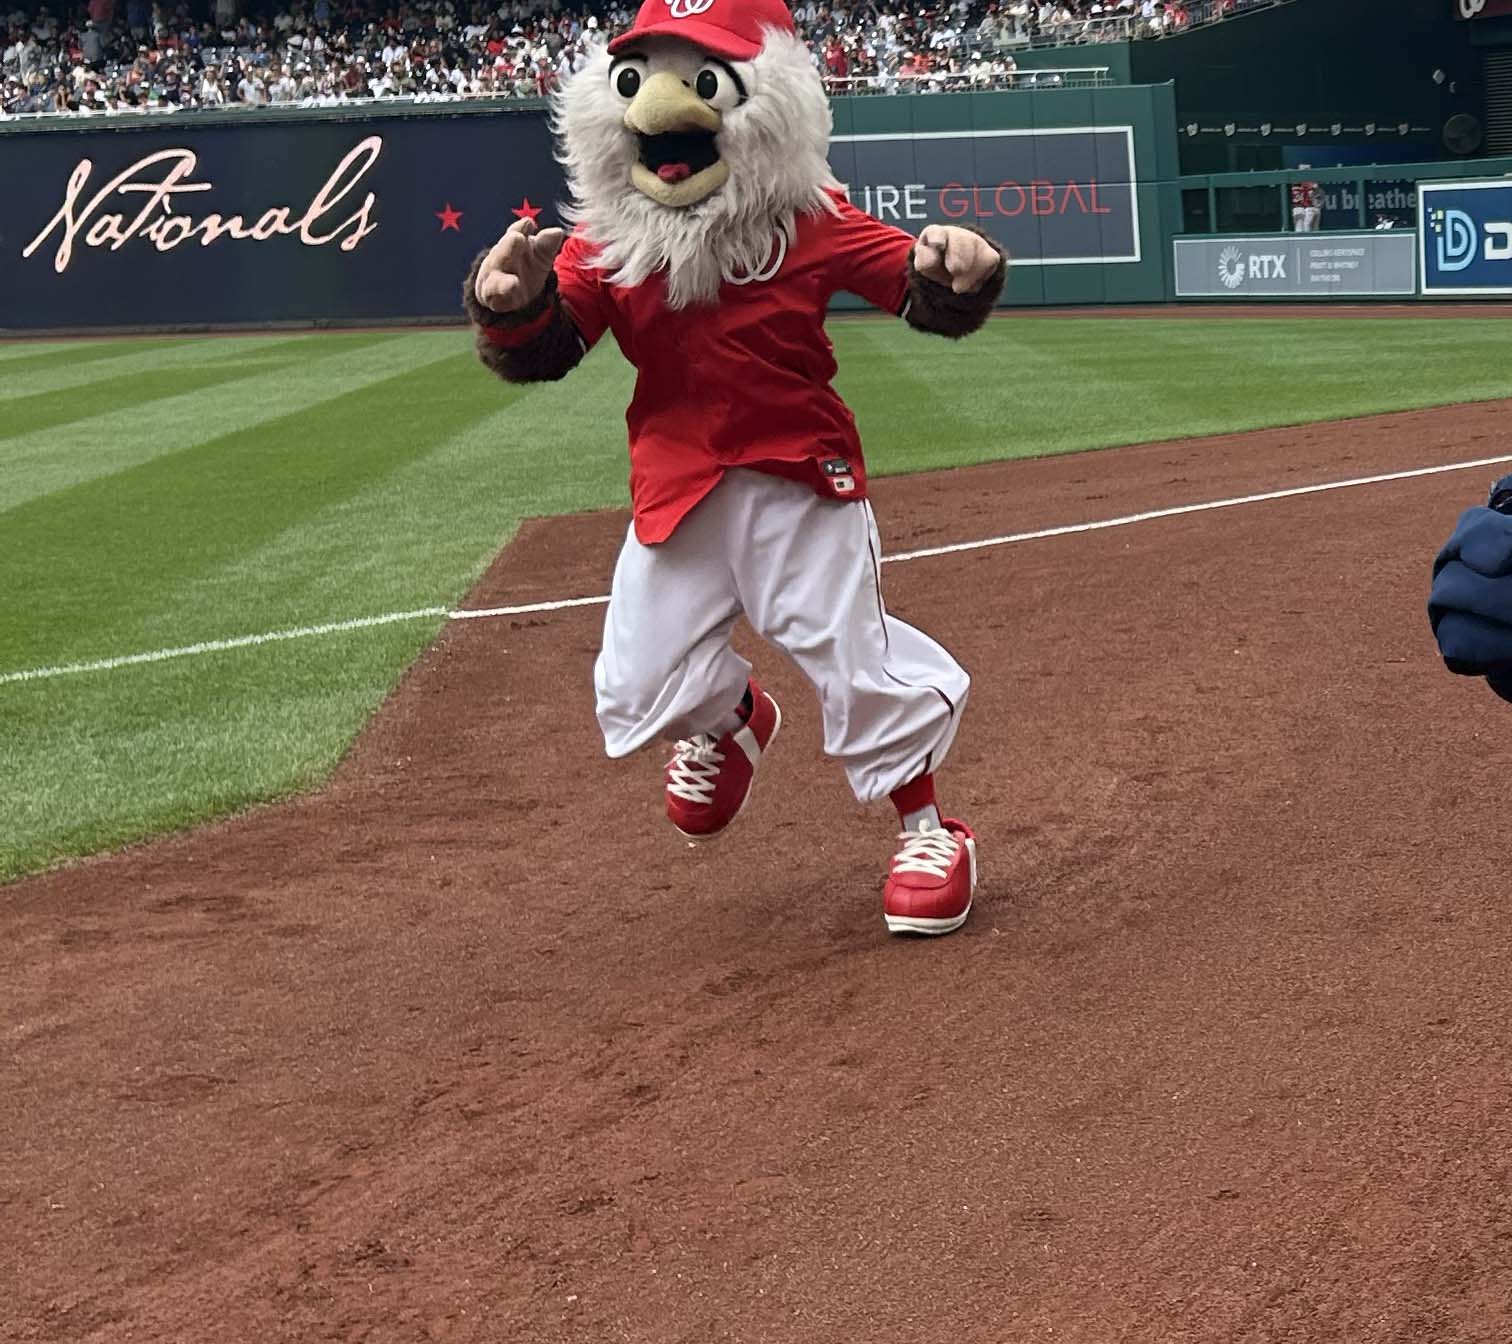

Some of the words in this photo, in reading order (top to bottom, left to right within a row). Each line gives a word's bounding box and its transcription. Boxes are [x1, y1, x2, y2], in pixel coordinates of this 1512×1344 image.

[22, 135, 383, 273] Nationals
[938, 177, 1112, 219] GLOBAL
[1249, 254, 1287, 279] RTX
